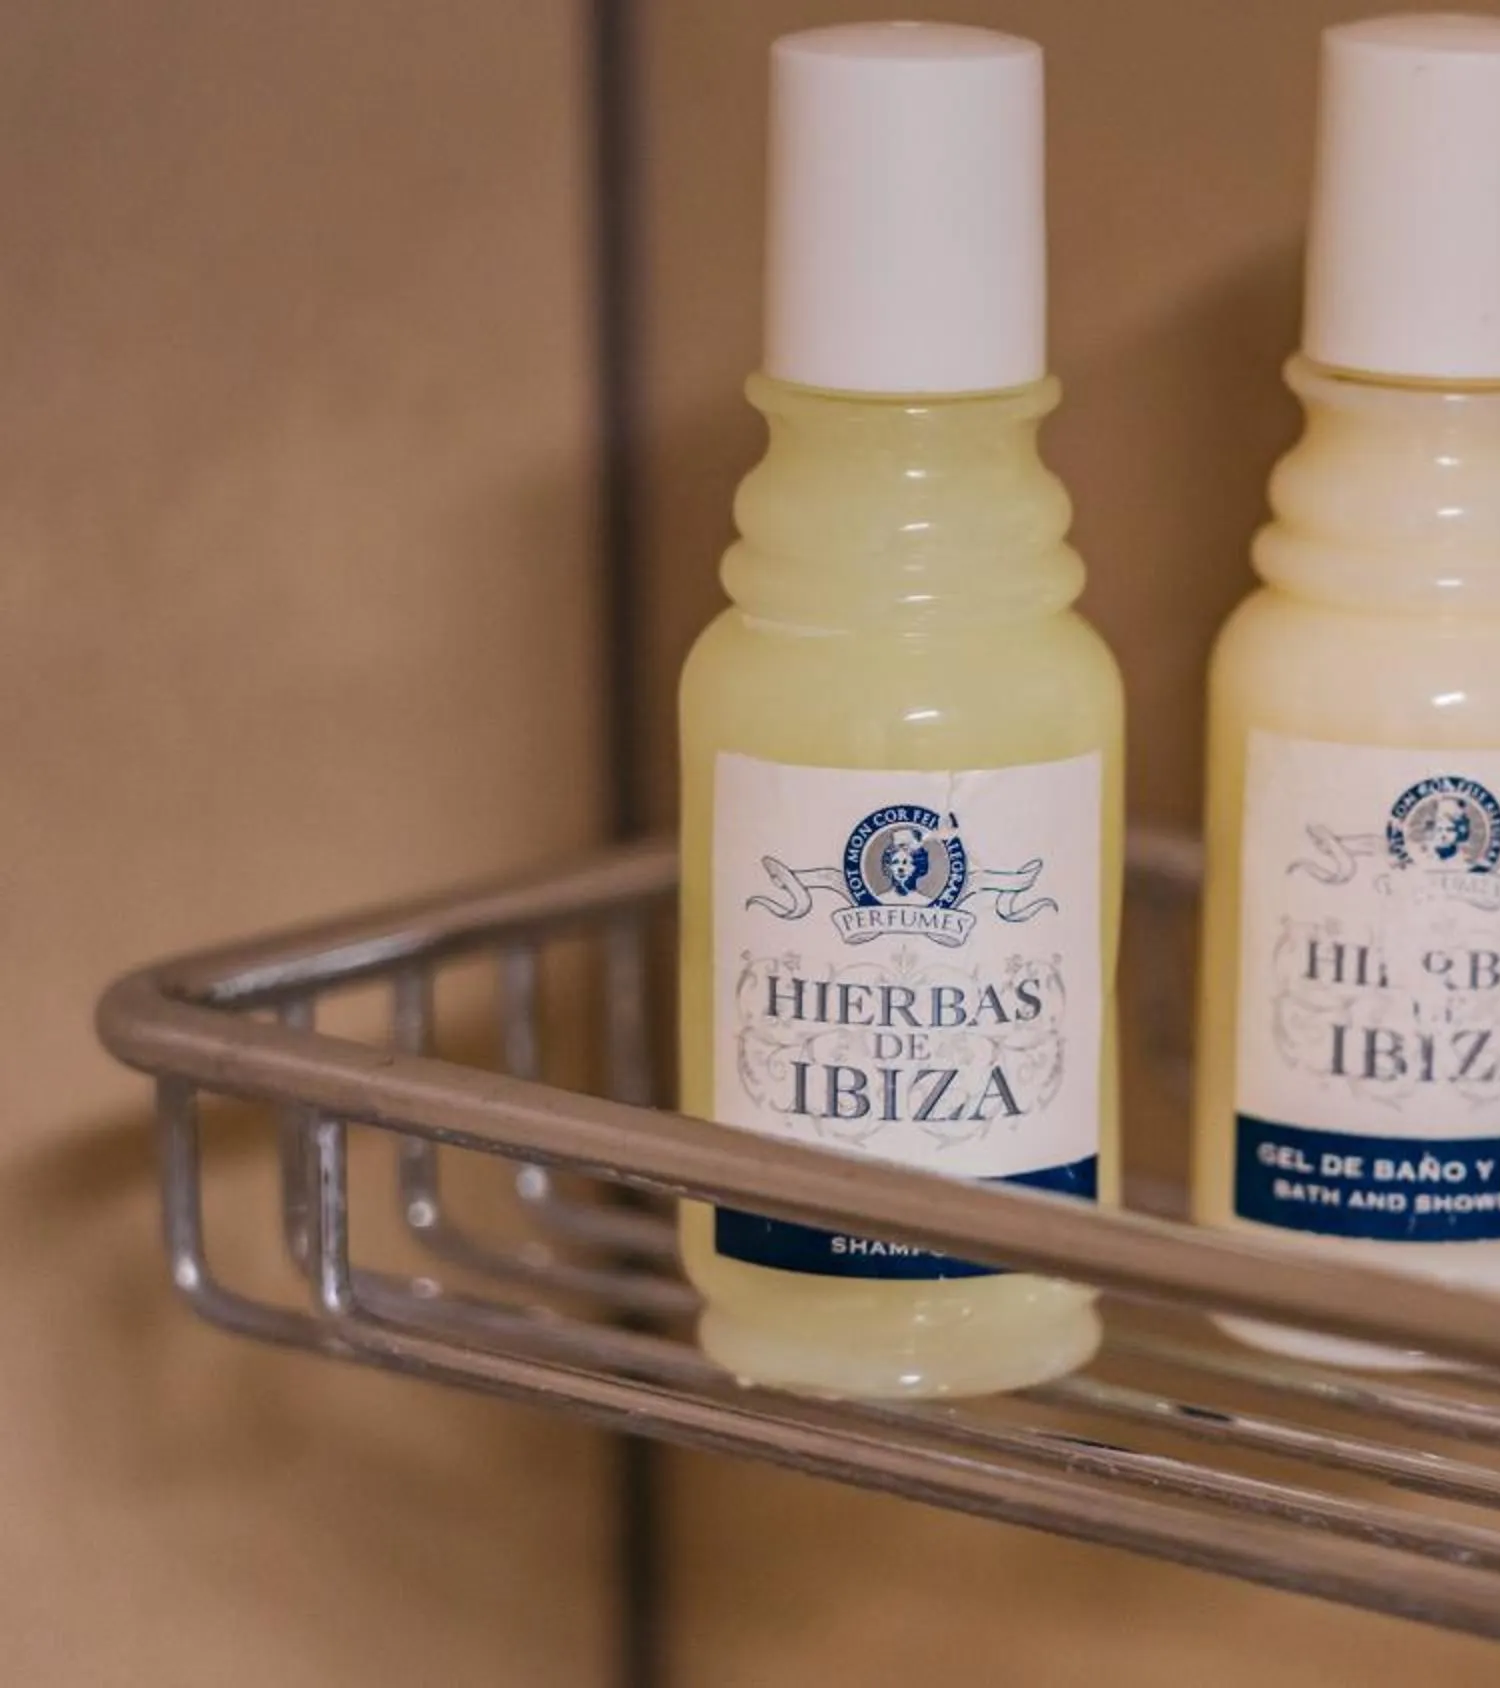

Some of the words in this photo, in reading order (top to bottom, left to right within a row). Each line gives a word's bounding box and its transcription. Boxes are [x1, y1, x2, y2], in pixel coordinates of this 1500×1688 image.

[873, 807, 909, 827] COR
[848, 823, 873, 863] MON
[848, 869, 867, 901] TOT
[842, 909, 966, 933] PERFUMES
[766, 975, 1043, 1028] HIERBAS
[873, 1032, 931, 1060] DE
[788, 1061, 1023, 1122] IBIZA
[1258, 1142, 1313, 1174] GEL
[1321, 1154, 1363, 1179] DE
[1373, 1151, 1467, 1182] BAÑO
[1476, 1160, 1495, 1181] Y
[1273, 1179, 1340, 1206] BATH
[1349, 1190, 1406, 1213] AND
